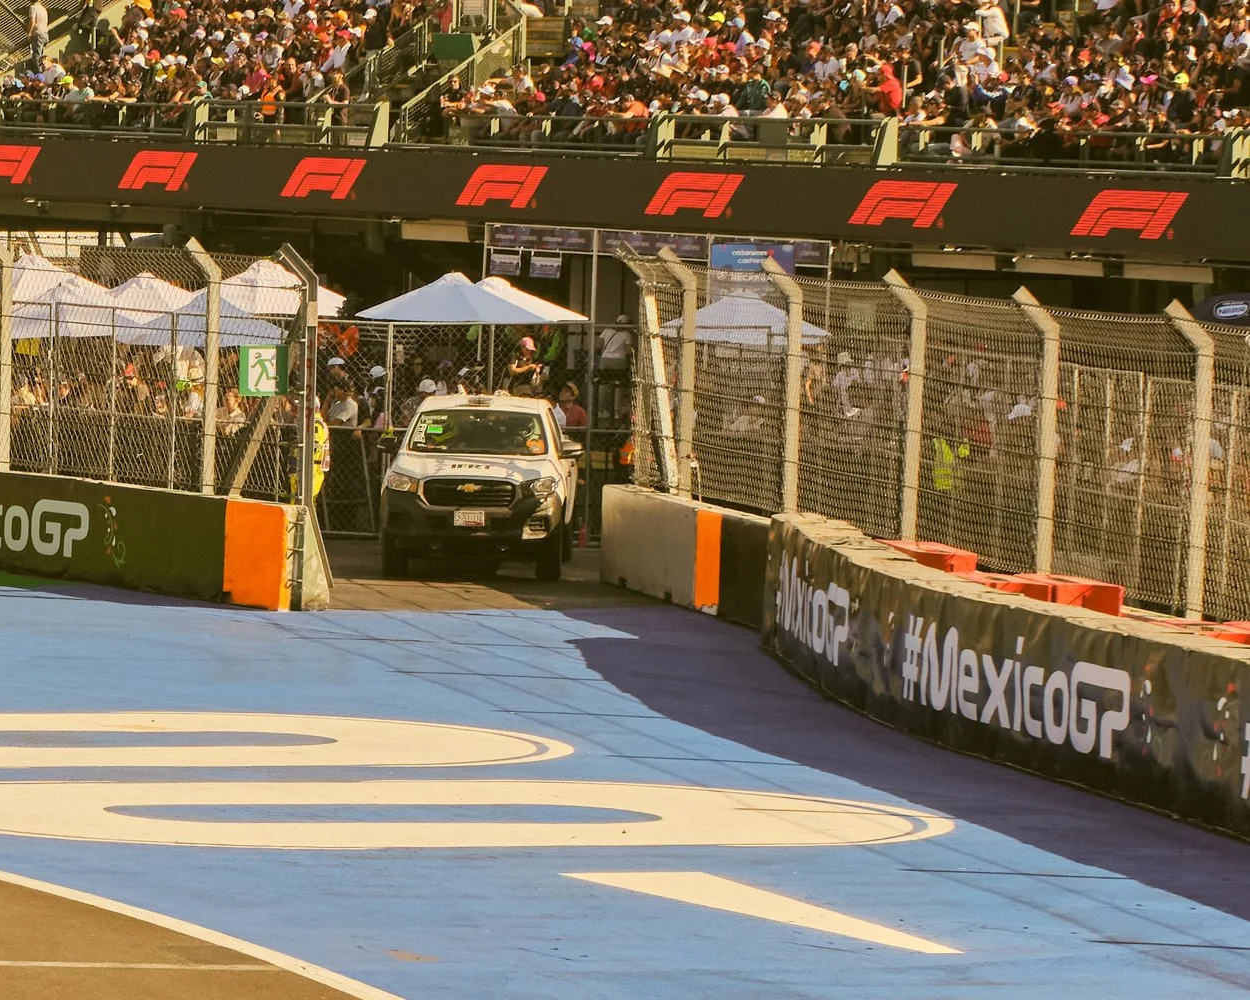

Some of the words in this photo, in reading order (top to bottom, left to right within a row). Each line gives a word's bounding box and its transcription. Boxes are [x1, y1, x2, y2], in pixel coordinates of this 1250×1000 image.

[118, 150, 198, 191] F1
[280, 157, 367, 200] F1
[456, 165, 549, 208] F1
[645, 172, 745, 218] F1
[849, 180, 958, 228] F1
[1070, 190, 1189, 239] F1
[776, 549, 850, 667] #MxicoGP
[902, 615, 1131, 759] #MexicoGP
